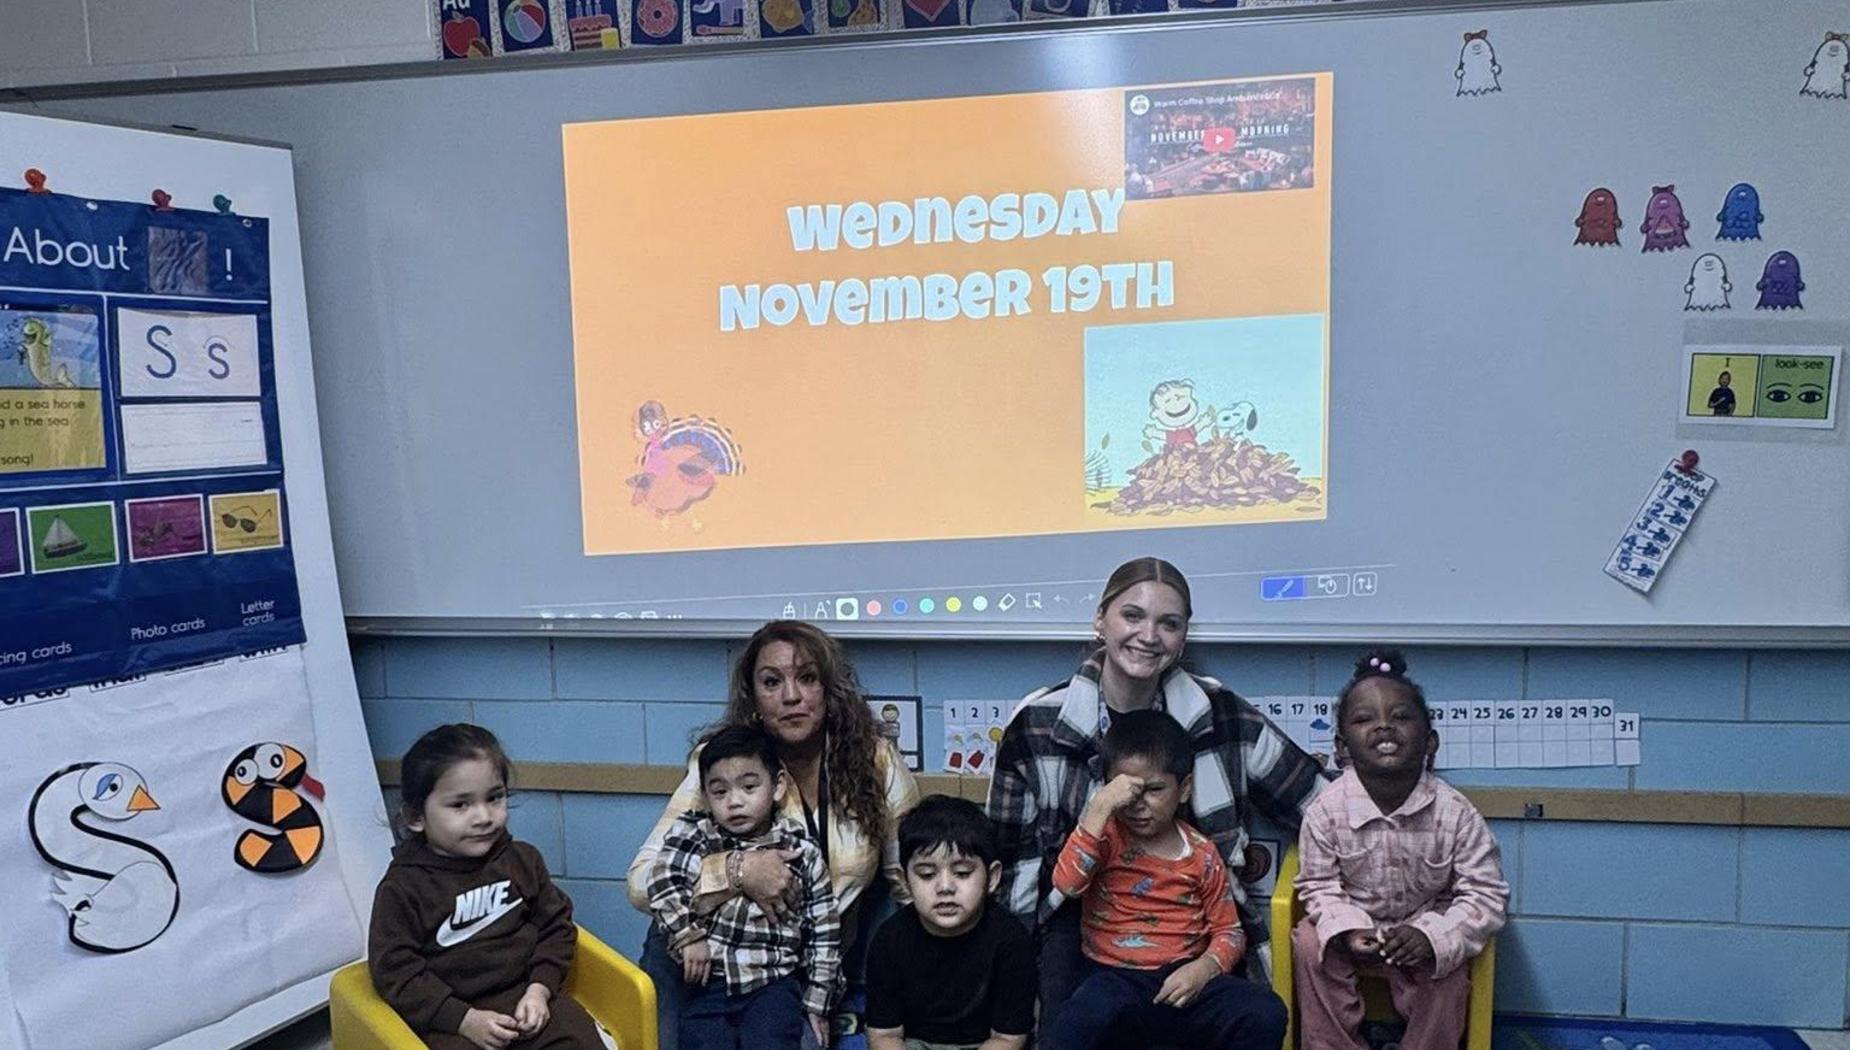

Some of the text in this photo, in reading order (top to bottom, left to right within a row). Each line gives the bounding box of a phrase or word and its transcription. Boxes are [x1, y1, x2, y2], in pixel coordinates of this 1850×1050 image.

[1241, 123, 1290, 136] MORNING
[3, 226, 131, 271] About
[1041, 260, 1175, 314] 19TH
[145, 324, 177, 379] S
[1775, 358, 1824, 370] look-see
[15, 401, 24, 410] a
[28, 401, 50, 410] sea
[53, 399, 86, 410] horse
[24, 416, 43, 426] the
[47, 417, 69, 426] sea
[240, 600, 275, 615] Letter
[242, 611, 275, 627] cards
[131, 617, 206, 640] Photo cards
[31, 641, 73, 659] cards
[951, 708, 956, 718] 1
[971, 707, 979, 718] 2
[992, 706, 1000, 718] 3
[1268, 704, 1283, 715] 16
[1291, 704, 1305, 715] 17
[1314, 704, 1328, 716] 18
[1450, 707, 1467, 719] 24
[1473, 707, 1491, 719] 25
[1497, 708, 1515, 719] 26
[1521, 707, 1539, 719] 27
[1545, 706, 1563, 718] 28
[1569, 706, 1588, 718] 29
[1592, 705, 1612, 717] 30
[1619, 719, 1634, 732] 31
[452, 880, 511, 924] NIKE
